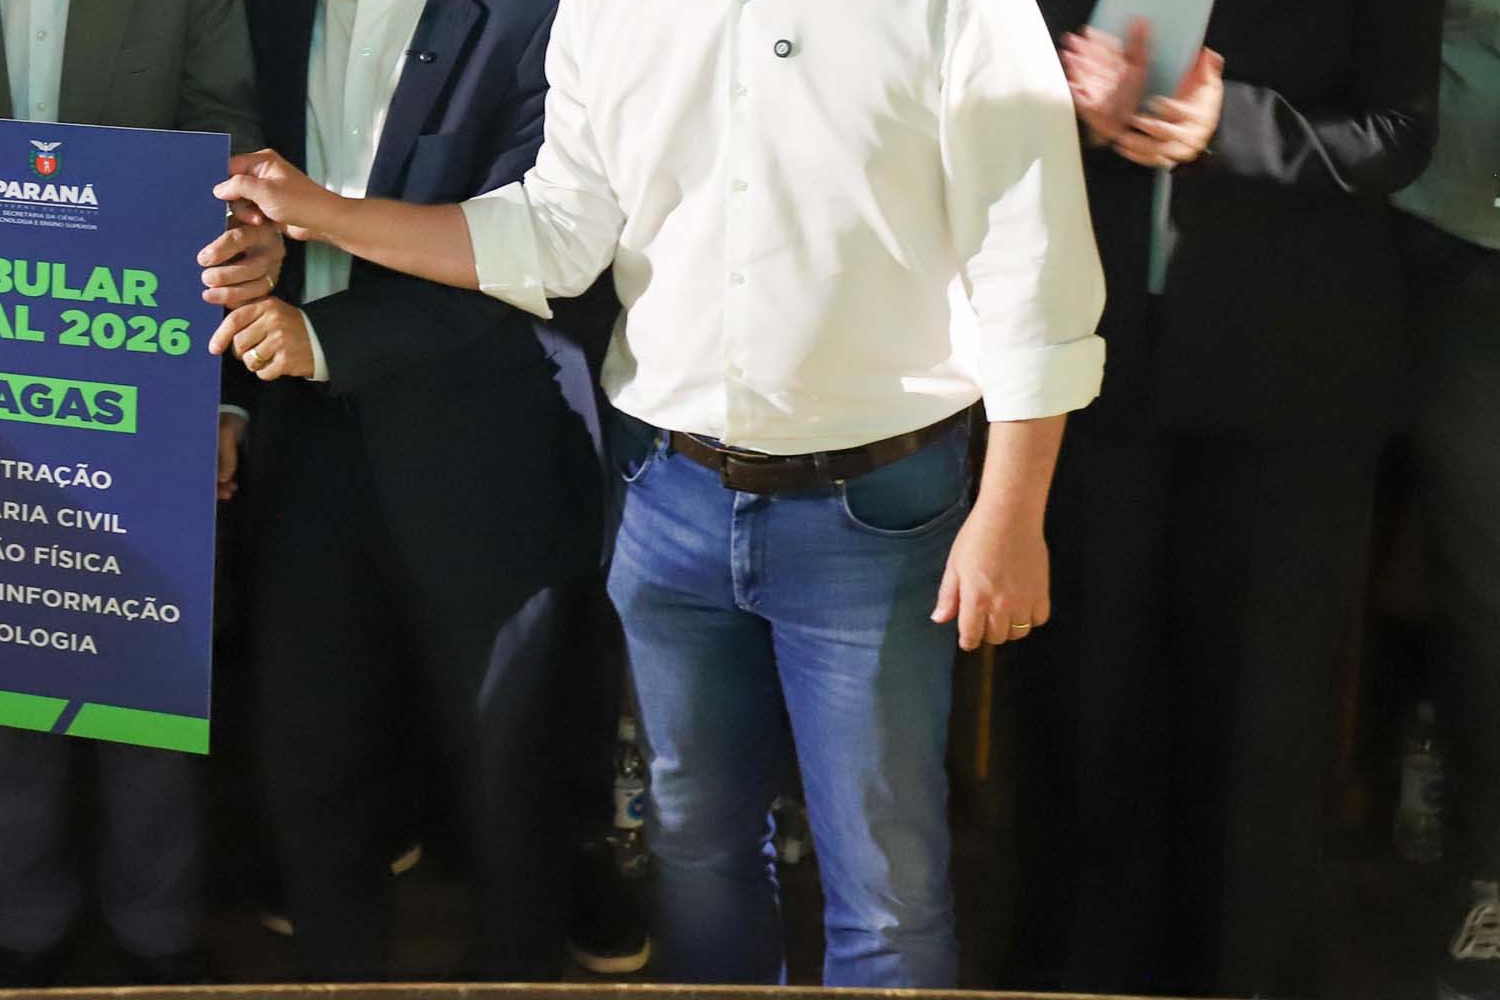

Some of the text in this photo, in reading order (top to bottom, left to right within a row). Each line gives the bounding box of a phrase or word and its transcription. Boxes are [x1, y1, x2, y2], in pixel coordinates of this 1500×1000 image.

[3, 210, 44, 218] SECRETARIA
[60, 310, 190, 355] 2026
[58, 509, 126, 533] CIVIL
[35, 545, 120, 574] FÍSICA
[0, 584, 180, 622] INFORMAÇÃO
